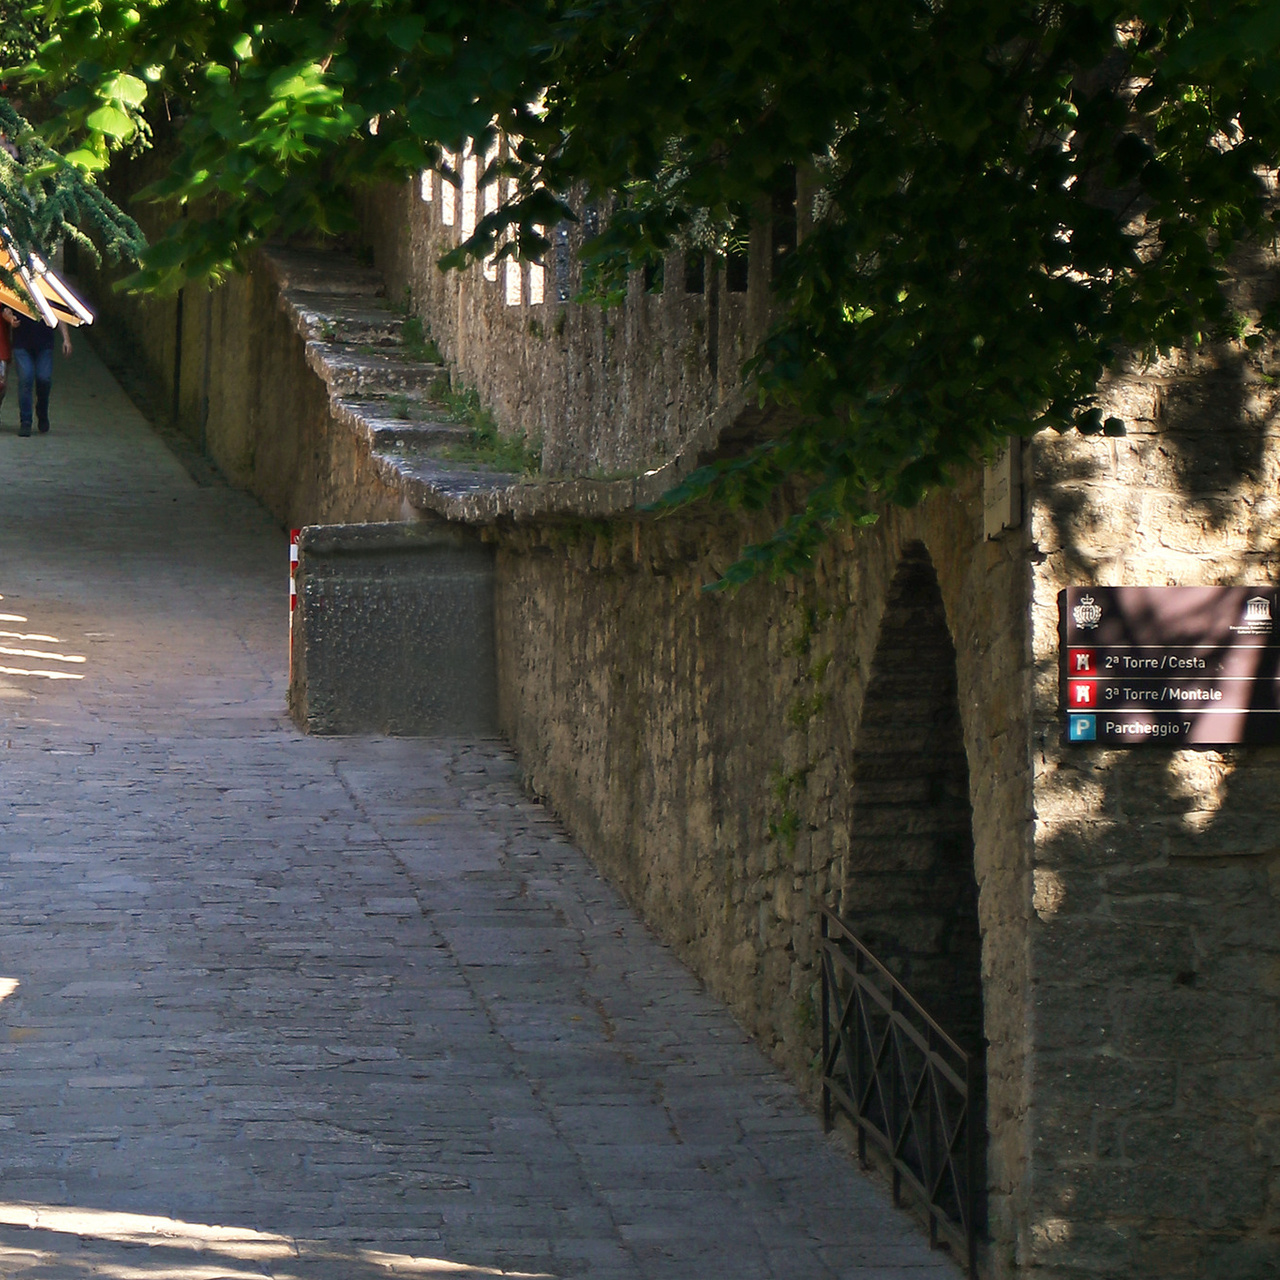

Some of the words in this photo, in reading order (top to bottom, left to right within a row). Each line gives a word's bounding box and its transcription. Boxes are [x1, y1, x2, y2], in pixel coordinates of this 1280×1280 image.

[1123, 656, 1159, 669] Torre
[1169, 656, 1206, 669] Cesta
[1123, 688, 1159, 700] Torre
[1170, 688, 1223, 701] Montale
[1106, 722, 1180, 737] Parcheggio
[1183, 722, 1191, 734] 7
